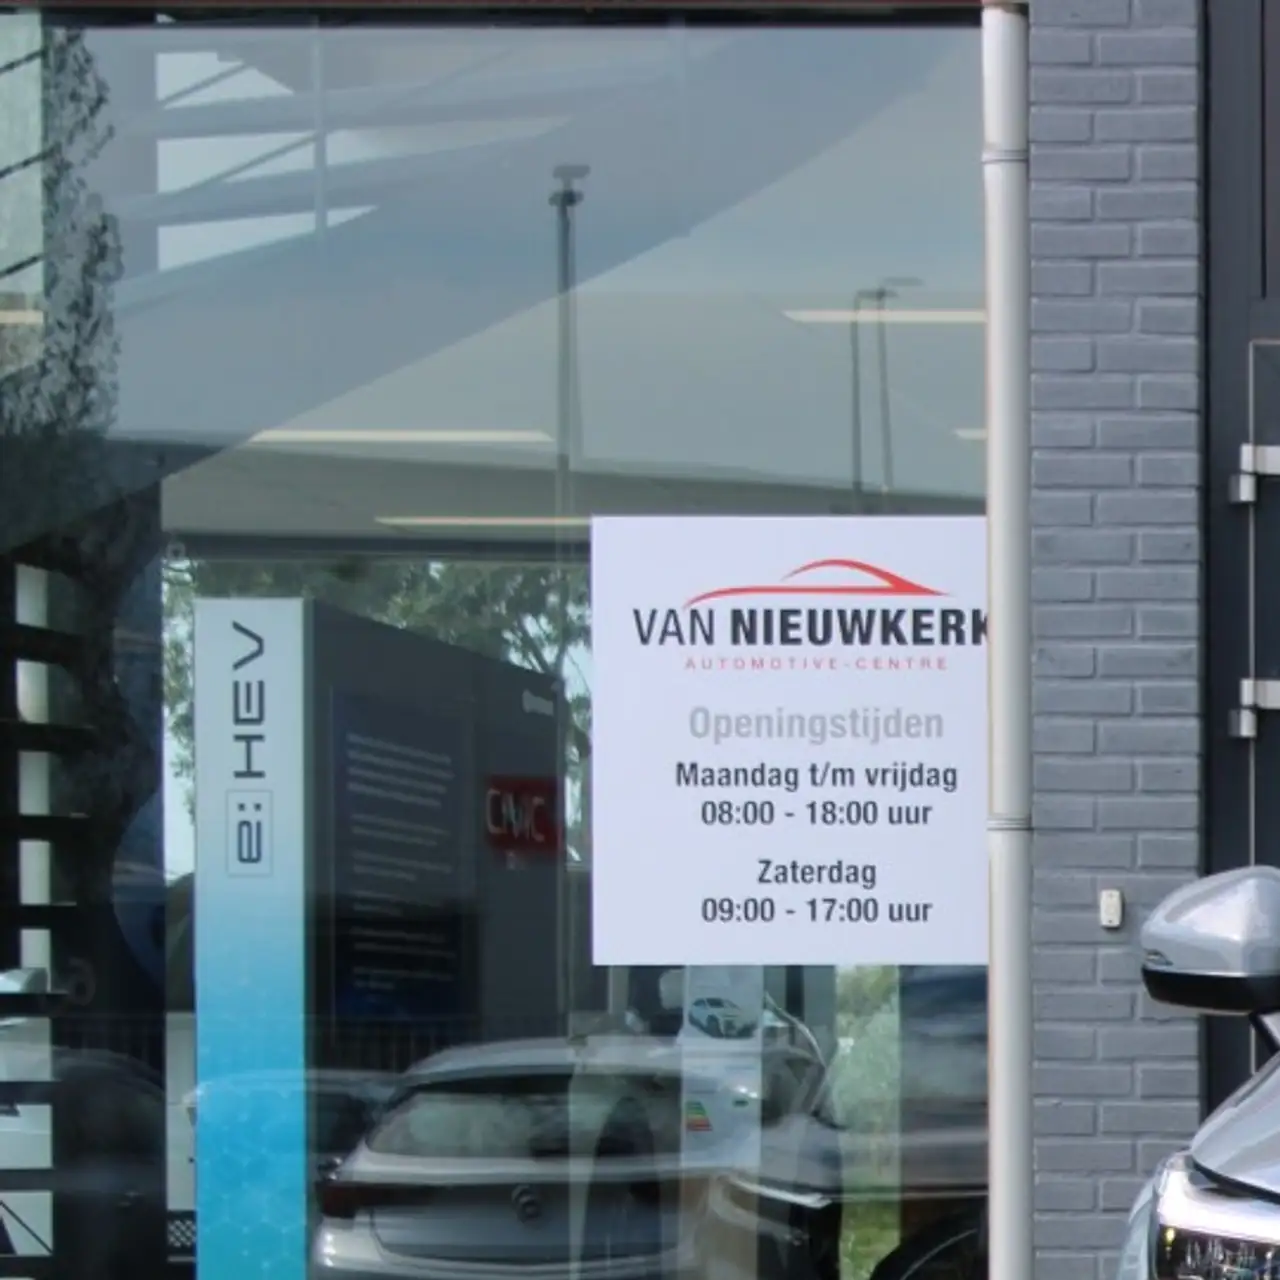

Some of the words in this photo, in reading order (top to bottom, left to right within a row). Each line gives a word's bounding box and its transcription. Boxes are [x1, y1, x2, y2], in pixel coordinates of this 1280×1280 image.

[633, 608, 715, 646] VAN
[730, 608, 989, 646] NIEUWKERK
[689, 706, 945, 745] Openingstijden
[676, 762, 799, 792] Maandag
[809, 762, 856, 788] t/m
[865, 762, 958, 792] vrijdag
[701, 800, 775, 826] 08:00
[807, 800, 878, 826] 18:00
[887, 804, 933, 826] uur
[757, 858, 877, 890] Zaterdag
[701, 897, 775, 923] 09:00
[807, 897, 879, 923] 17:00
[888, 902, 933, 923] uur
